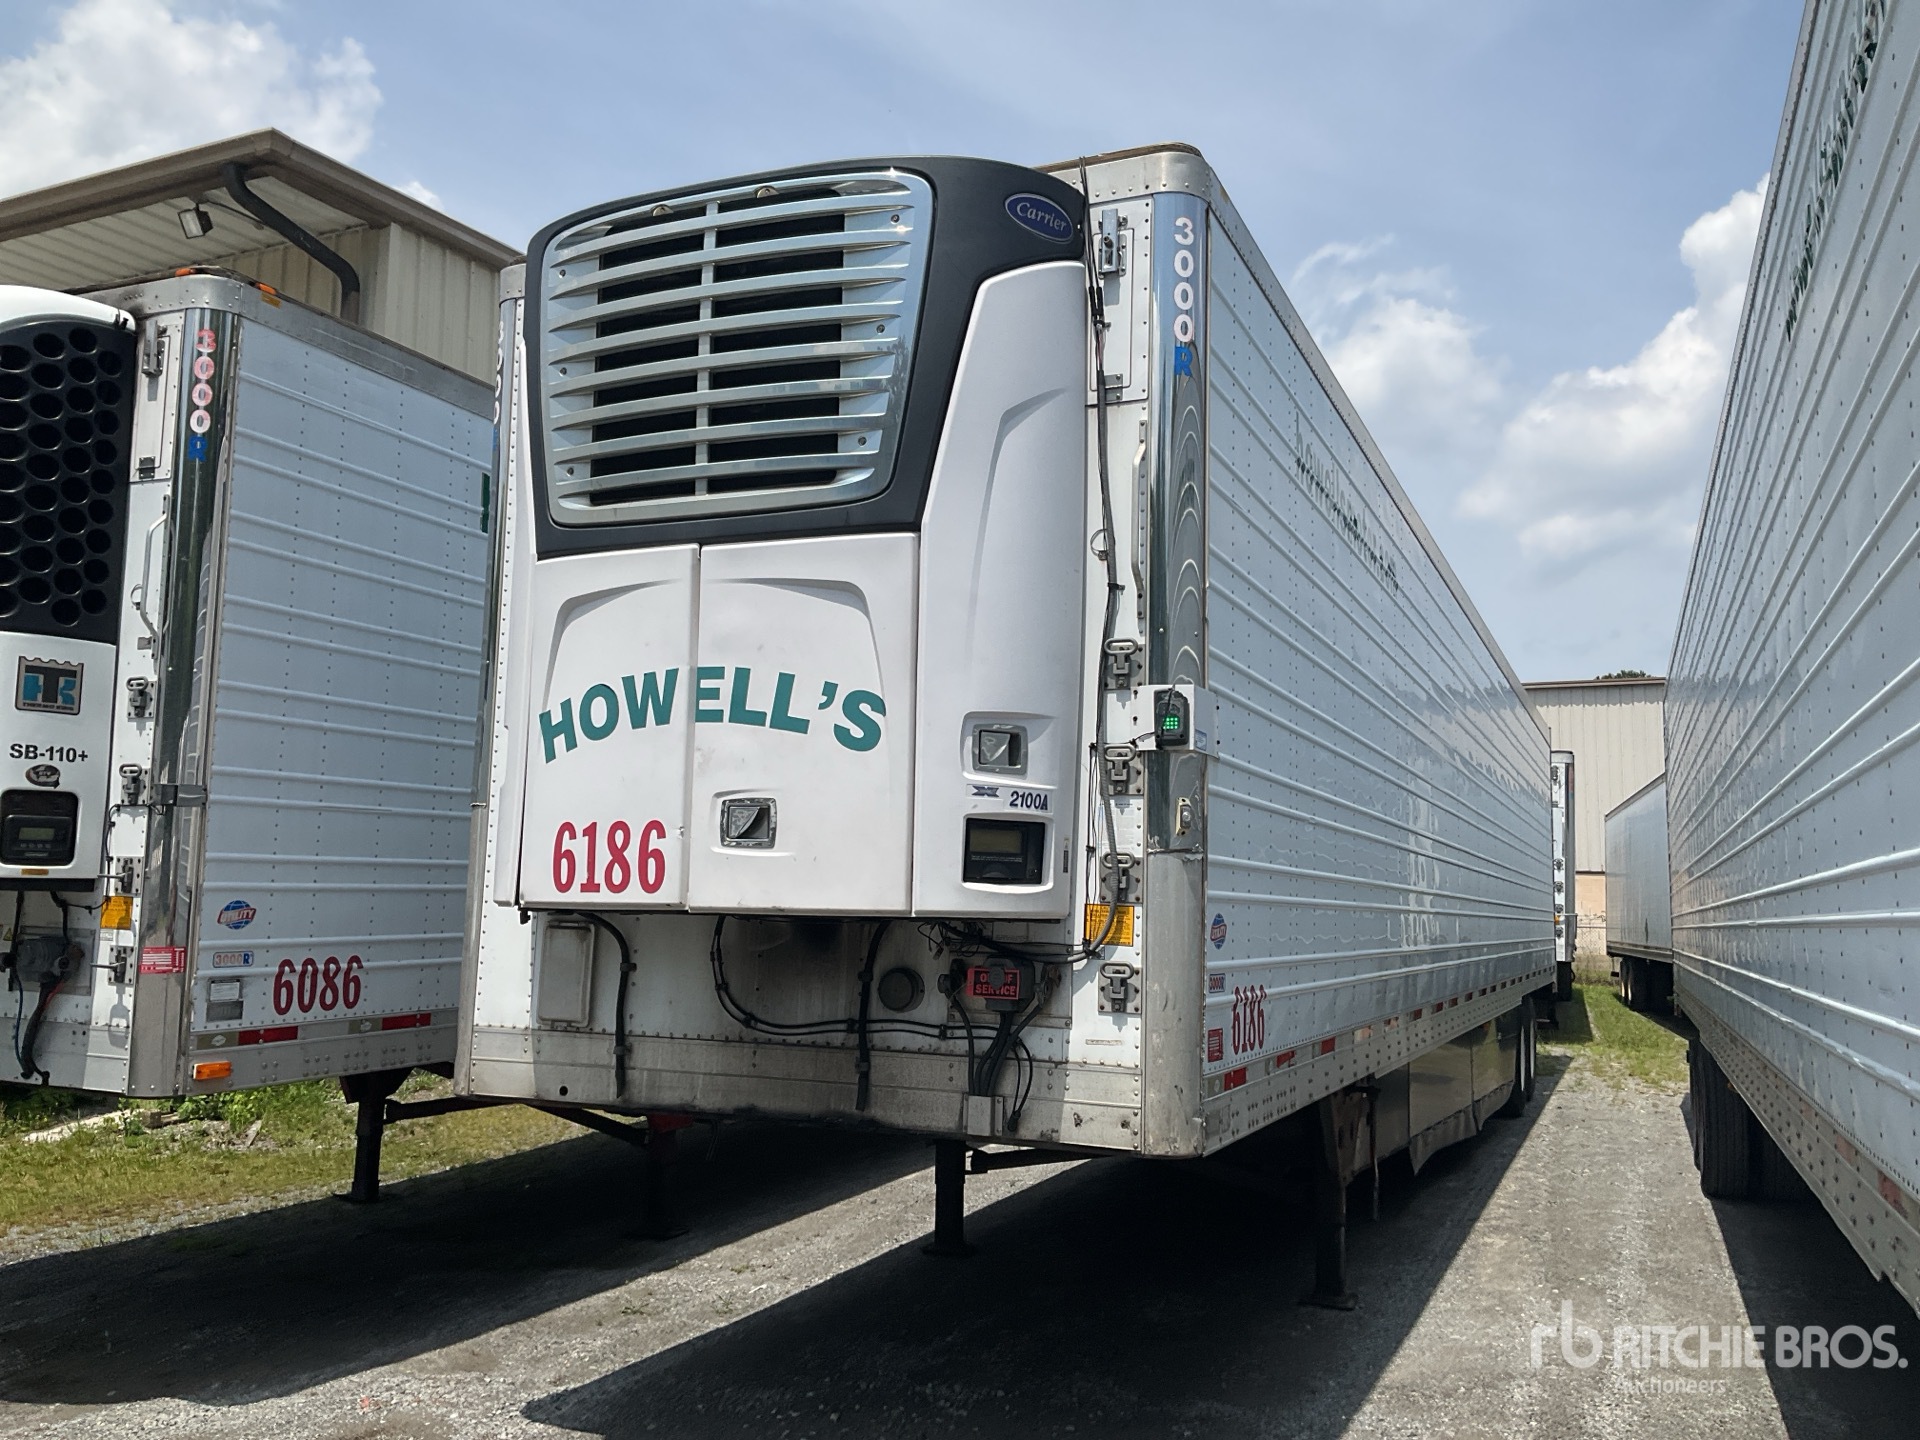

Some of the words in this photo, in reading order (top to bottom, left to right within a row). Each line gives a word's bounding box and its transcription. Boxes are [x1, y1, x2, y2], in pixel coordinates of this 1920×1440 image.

[1015, 201, 1067, 232] Carrier
[1173, 216, 1195, 377] 3000R
[538, 666, 887, 764] HOWELL'S
[9, 743, 88, 763] SB-110+
[1009, 790, 1048, 811] 2100A
[552, 819, 667, 894] 6186
[219, 908, 256, 924] UTILITY
[272, 954, 364, 1016] 6086
[1232, 984, 1268, 1056] 6186
